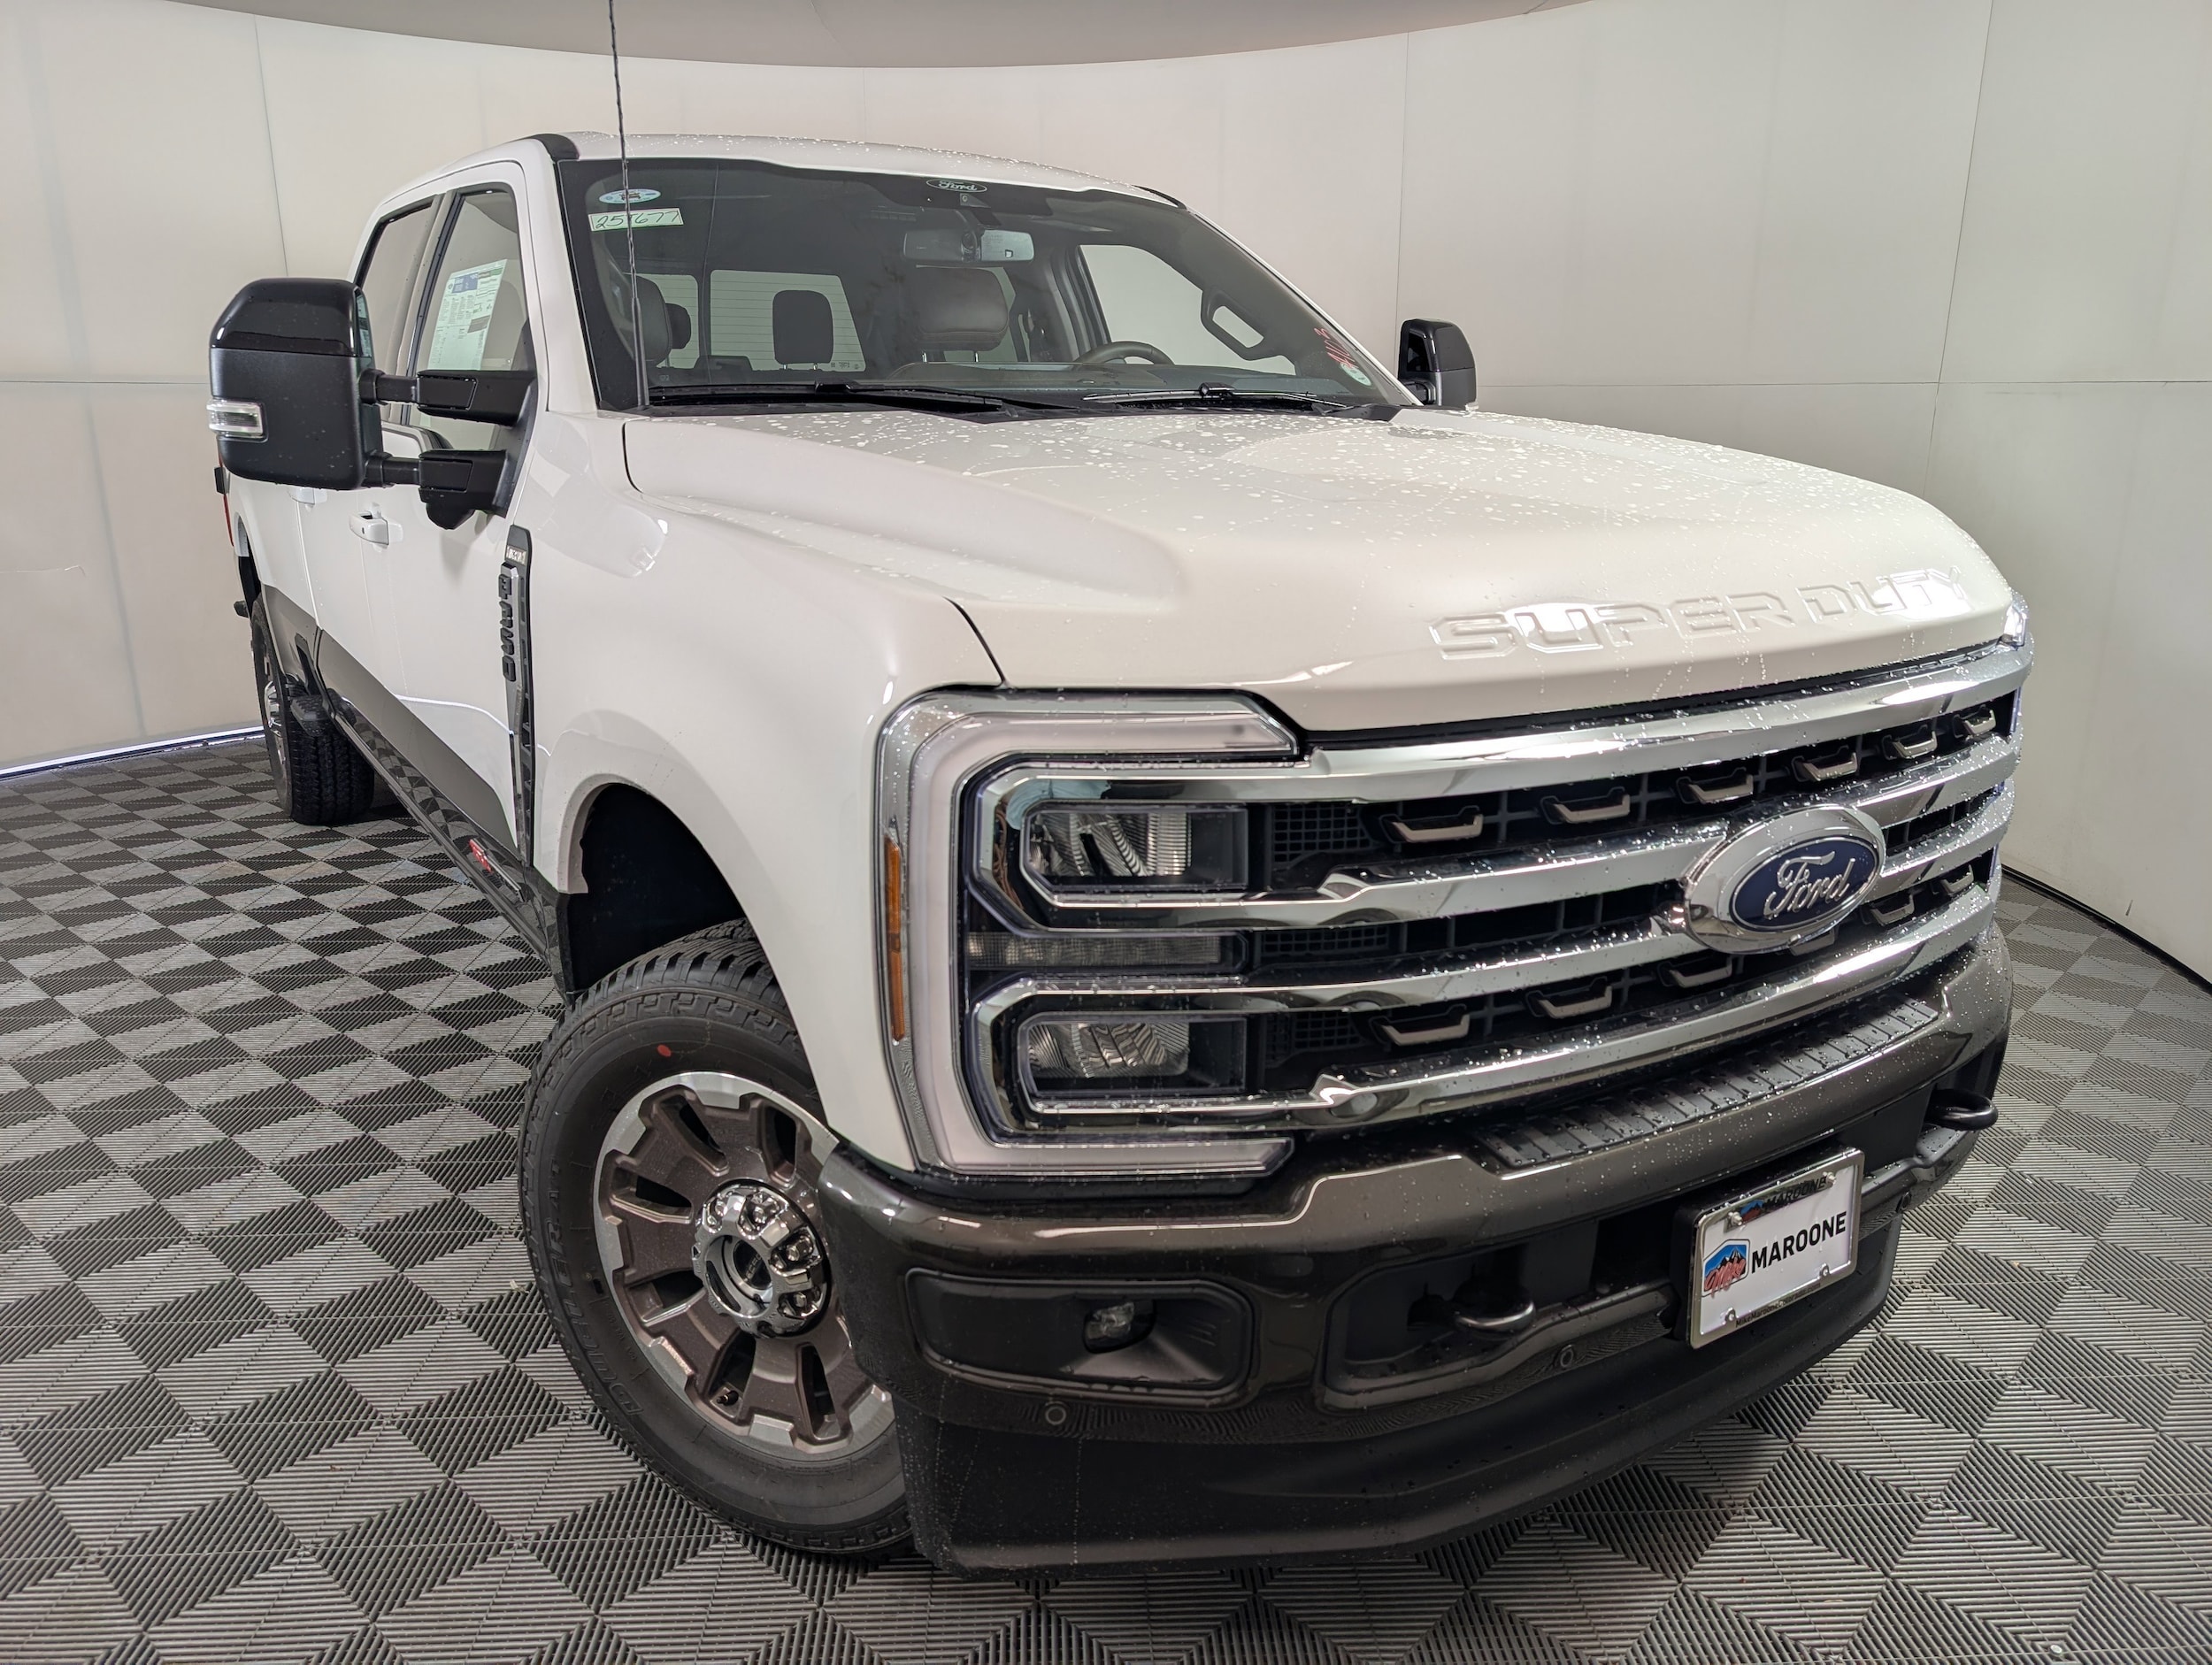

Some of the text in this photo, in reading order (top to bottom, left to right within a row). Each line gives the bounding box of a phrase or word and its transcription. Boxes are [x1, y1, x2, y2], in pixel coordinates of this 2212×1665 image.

[1429, 565, 1969, 660] SUPER DUTY
[1763, 851, 1856, 921] Ford
[1751, 1210, 1847, 1275] MAROONE
